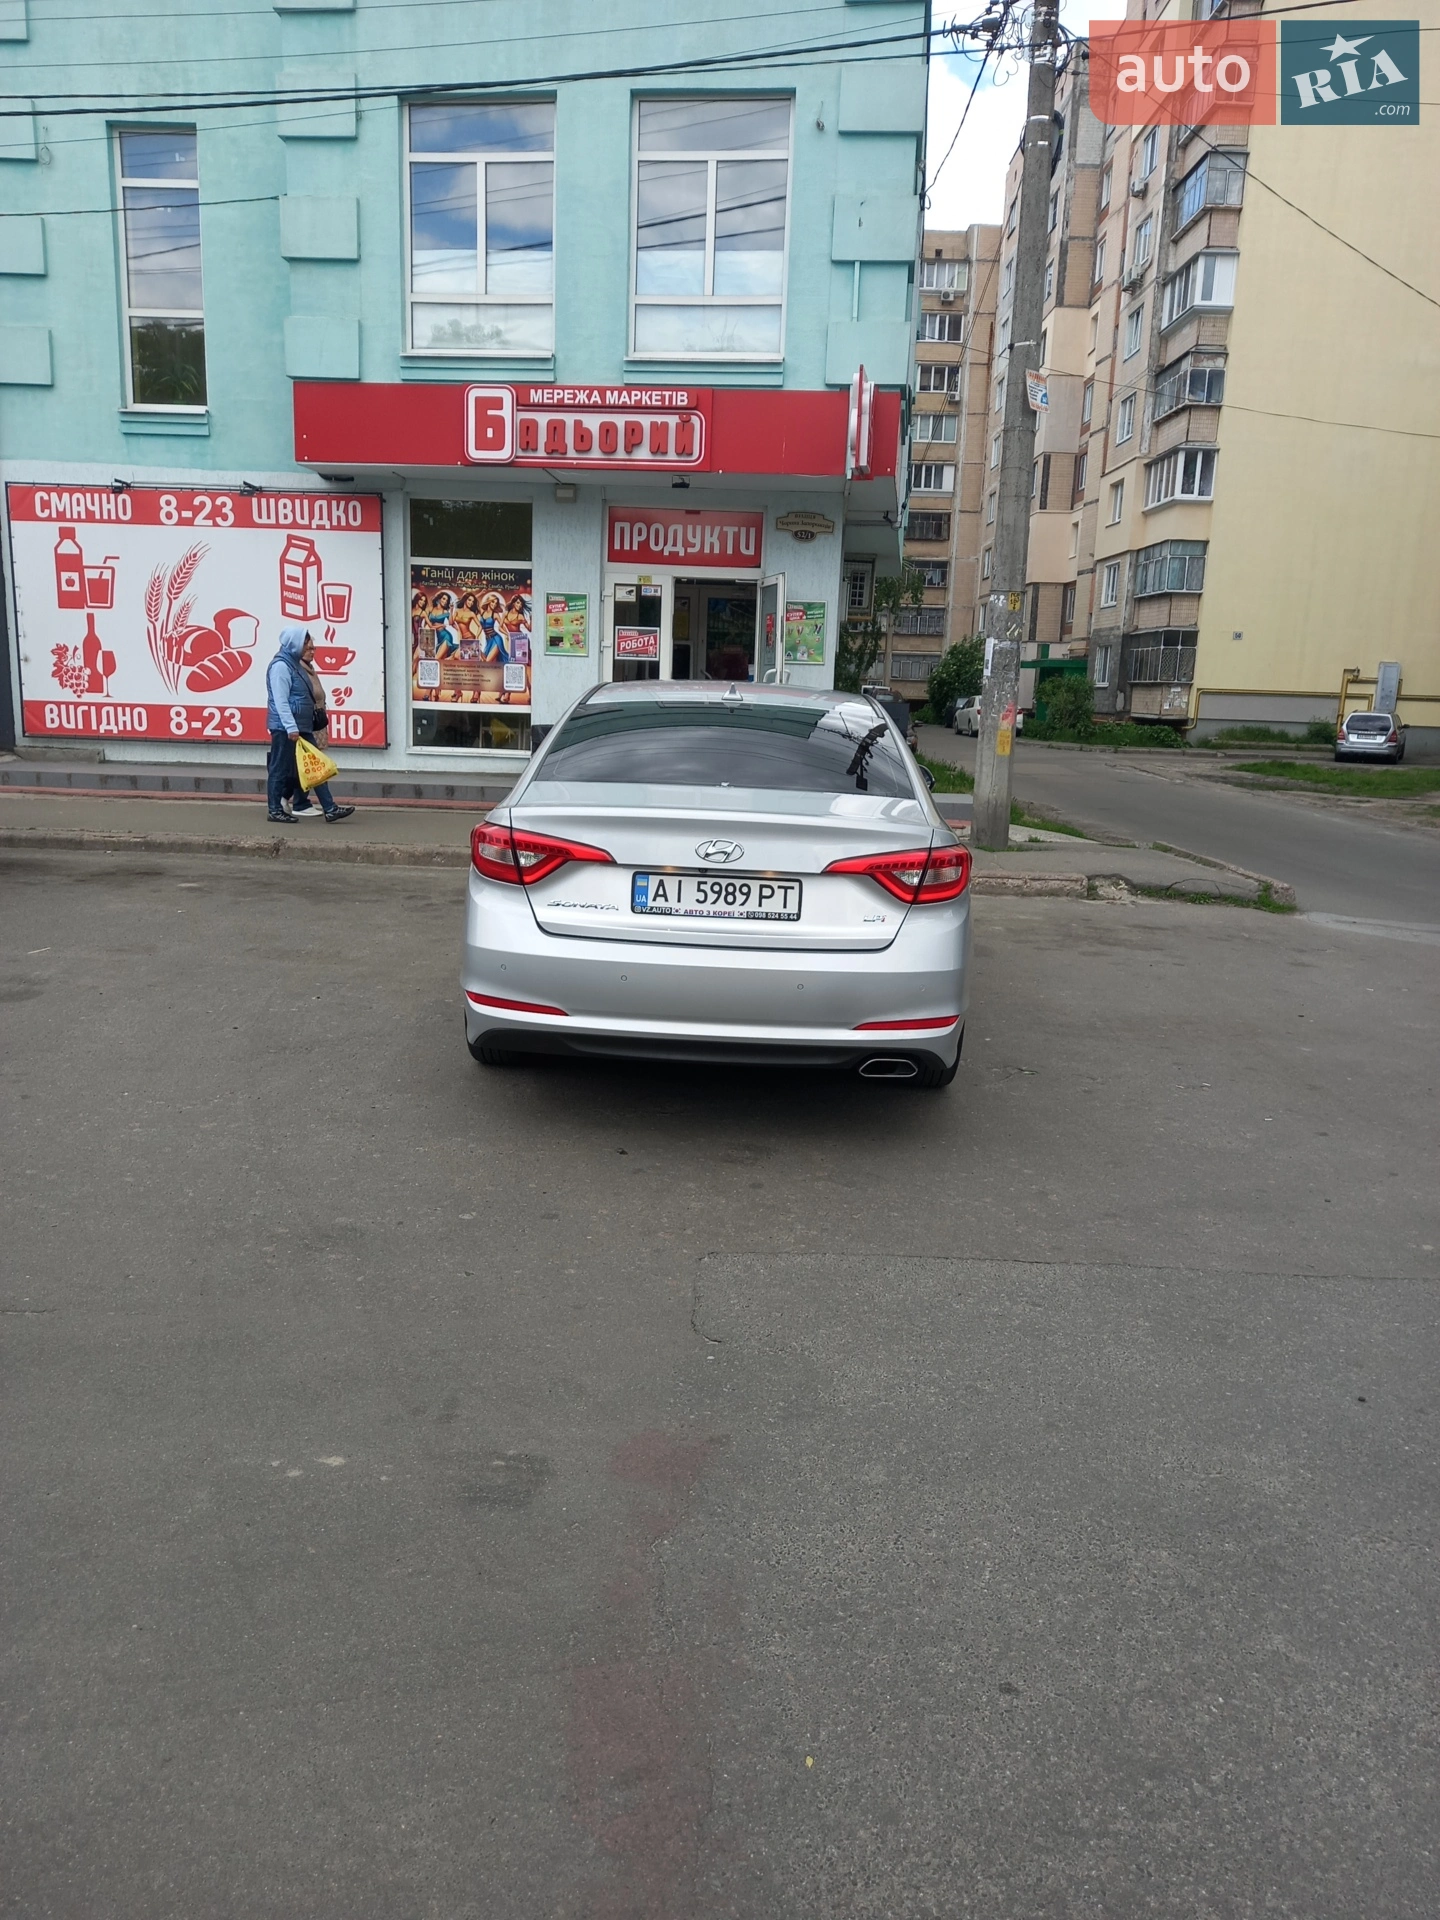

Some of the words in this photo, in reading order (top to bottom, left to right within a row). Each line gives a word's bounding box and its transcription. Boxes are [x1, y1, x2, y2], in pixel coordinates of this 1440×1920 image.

[530, 389, 602, 405] МЕРЕЖА
[606, 390, 688, 406] МАРКЕТІВ
[474, 395, 695, 456] БАДЬОРИЙ
[34, 491, 132, 520] СМАЧНО
[159, 494, 235, 527] 8-23
[251, 497, 363, 529] ШВИДКО
[614, 521, 755, 557] ПРОДУКТИ
[423, 567, 454, 581] Танці
[457, 571, 478, 581] для
[481, 570, 515, 581] жінок
[620, 636, 655, 651] РОБОТА
[45, 703, 148, 733] ВИГІДНО
[170, 707, 243, 737] 8-23
[547, 900, 619, 911] SONATA
[636, 894, 647, 903] UA
[652, 879, 682, 903] AI
[695, 881, 752, 906] 5989
[758, 884, 794, 909] PT
[713, 909, 735, 917] КОРЕЇ
